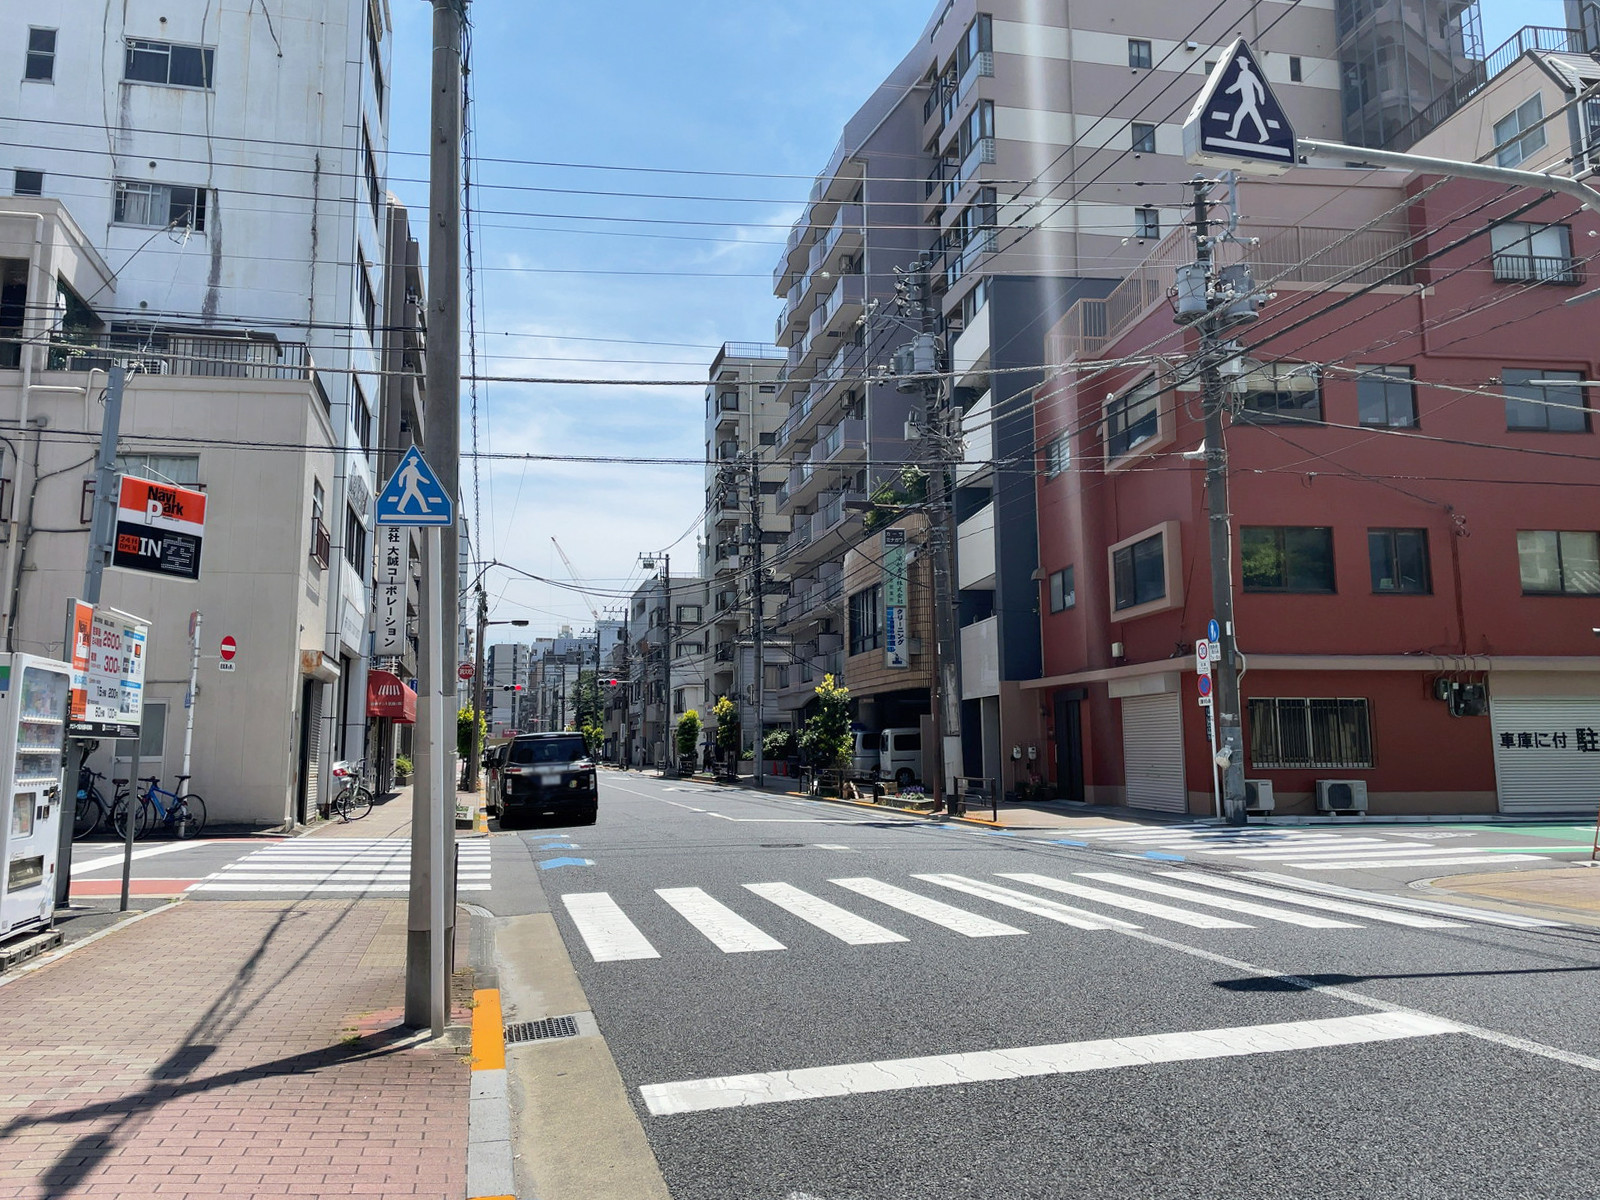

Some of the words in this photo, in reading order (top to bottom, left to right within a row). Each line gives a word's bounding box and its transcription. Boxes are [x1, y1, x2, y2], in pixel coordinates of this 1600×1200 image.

[147, 486, 176, 504] Navi
[145, 498, 184, 525] Park
[138, 537, 162, 558] IN
[1500, 731, 1567, 749] 車庫に付
[1575, 727, 1600, 752] 駐
